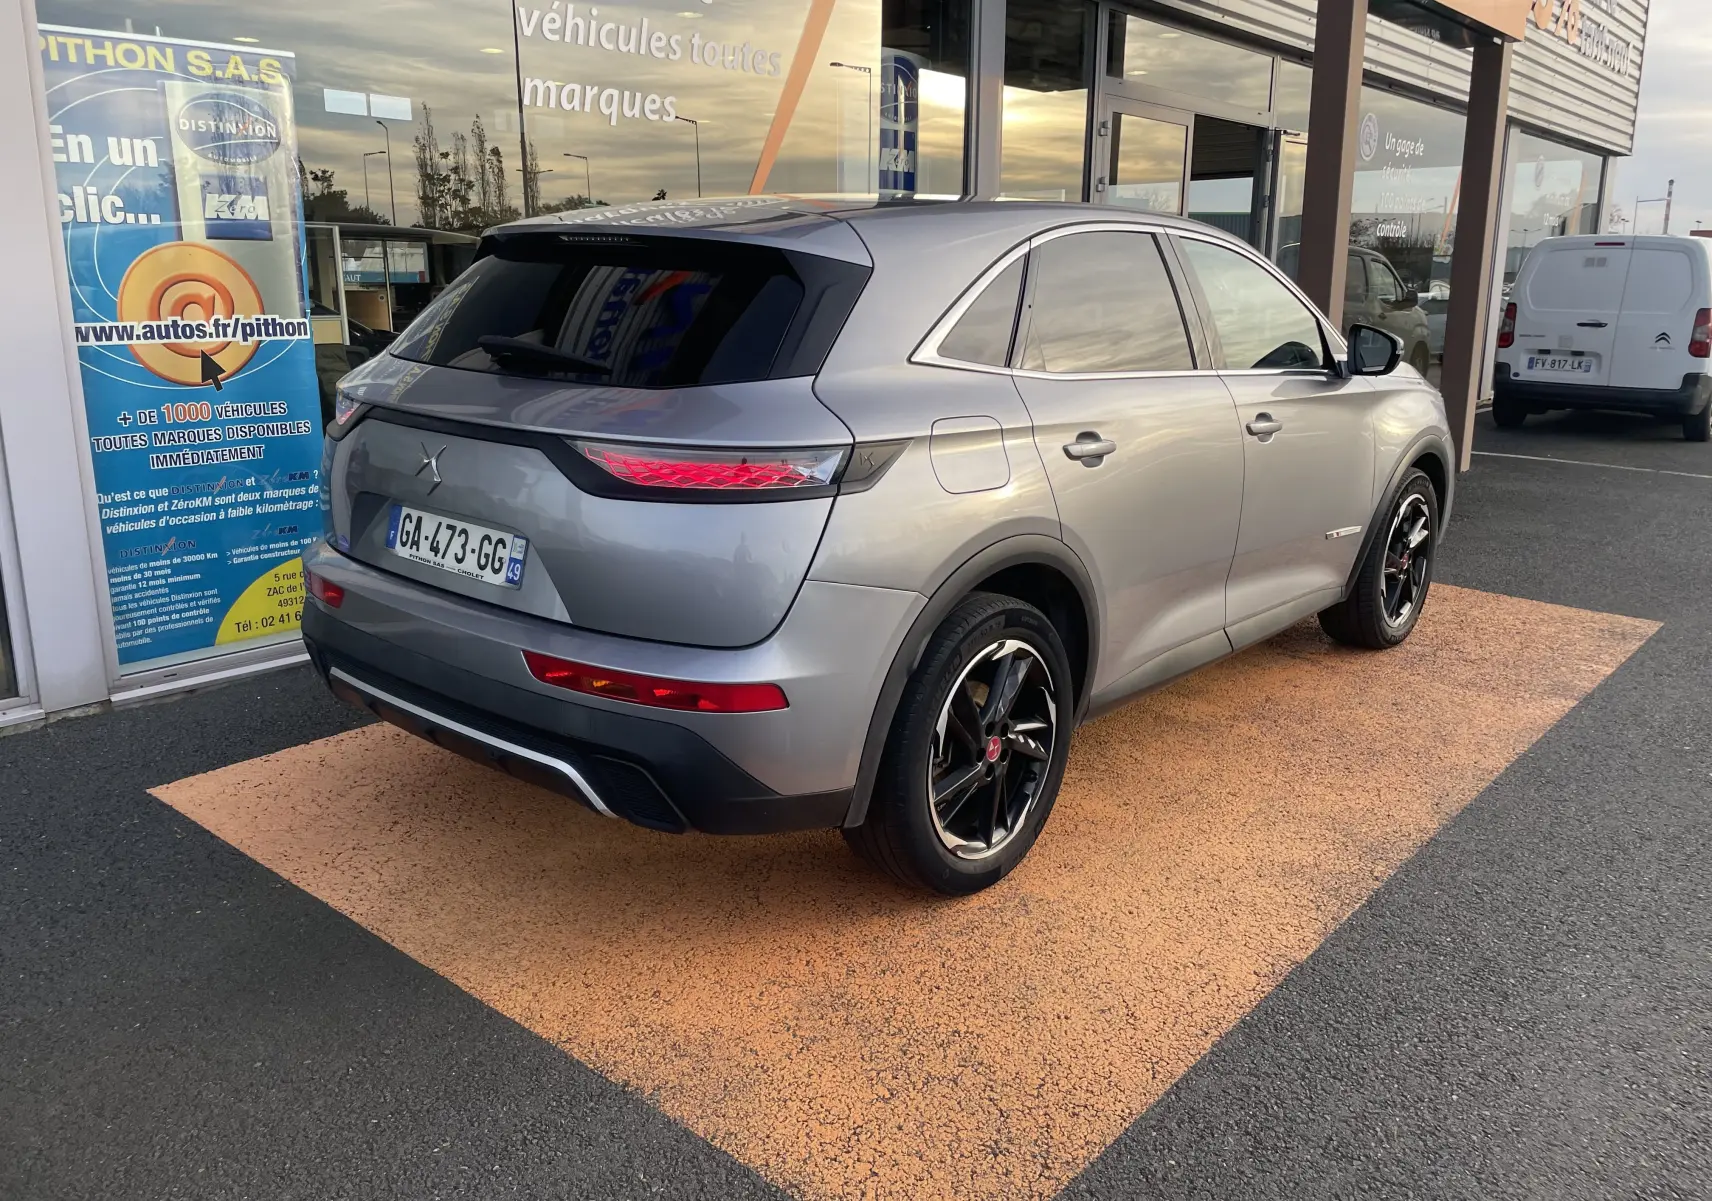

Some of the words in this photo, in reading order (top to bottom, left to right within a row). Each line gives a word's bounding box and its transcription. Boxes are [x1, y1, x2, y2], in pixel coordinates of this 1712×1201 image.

[518, 1, 681, 60] véhicules
[691, 31, 782, 77] toutes
[522, 77, 677, 126] marques
[179, 118, 277, 138] DISTINXION
[49, 125, 95, 164] En
[107, 136, 159, 168] un
[1385, 132, 1395, 150] Un
[1396, 139, 1415, 158] gage
[1415, 138, 1424, 156] de
[1376, 220, 1407, 238] contrôle
[75, 317, 309, 343] www.autos.fr/pithon
[138, 411, 156, 424] DE
[162, 403, 211, 422] 1000
[216, 402, 287, 419] VÉHICULES
[93, 434, 148, 452] TOUTES
[154, 429, 221, 446] MARQUES
[227, 422, 311, 440] DISPONIBLES
[151, 446, 264, 468] IMMÉDIATEMENT
[133, 490, 146, 499] ce
[149, 488, 168, 499] que
[171, 478, 243, 495] DISTINXION
[246, 477, 256, 486] et
[101, 504, 154, 519] Distinxion
[158, 501, 168, 512] et
[171, 496, 212, 510] ZéroKM
[214, 495, 235, 506] sont
[237, 491, 261, 502] deux
[263, 487, 306, 499] marques
[308, 484, 319, 494] de
[106, 518, 156, 534] véhicules
[159, 512, 216, 527] d'occasion
[219, 509, 225, 519] à
[228, 506, 253, 518] faible
[120, 537, 197, 558] DISTINXION
[231, 546, 259, 555] Véhicules
[269, 542, 289, 550] moins
[400, 513, 507, 575] GA-473-GG
[149, 559, 171, 568] moins
[183, 553, 205, 563] 30000
[233, 555, 259, 564] Garantie
[260, 548, 300, 560] constructeur
[409, 554, 432, 564] PITHON
[432, 561, 445, 569] SAS
[457, 568, 485, 580] CHOLET
[110, 575, 132, 584] moins
[154, 568, 171, 576] mois
[149, 578, 166, 587] mois
[274, 574, 280, 582] 5
[282, 572, 297, 580] rue
[508, 563, 521, 581] 49
[266, 586, 284, 596] ZAC
[286, 584, 297, 593] de
[235, 620, 252, 633] Tél
[261, 615, 275, 628] 02
[279, 612, 291, 624] 41
